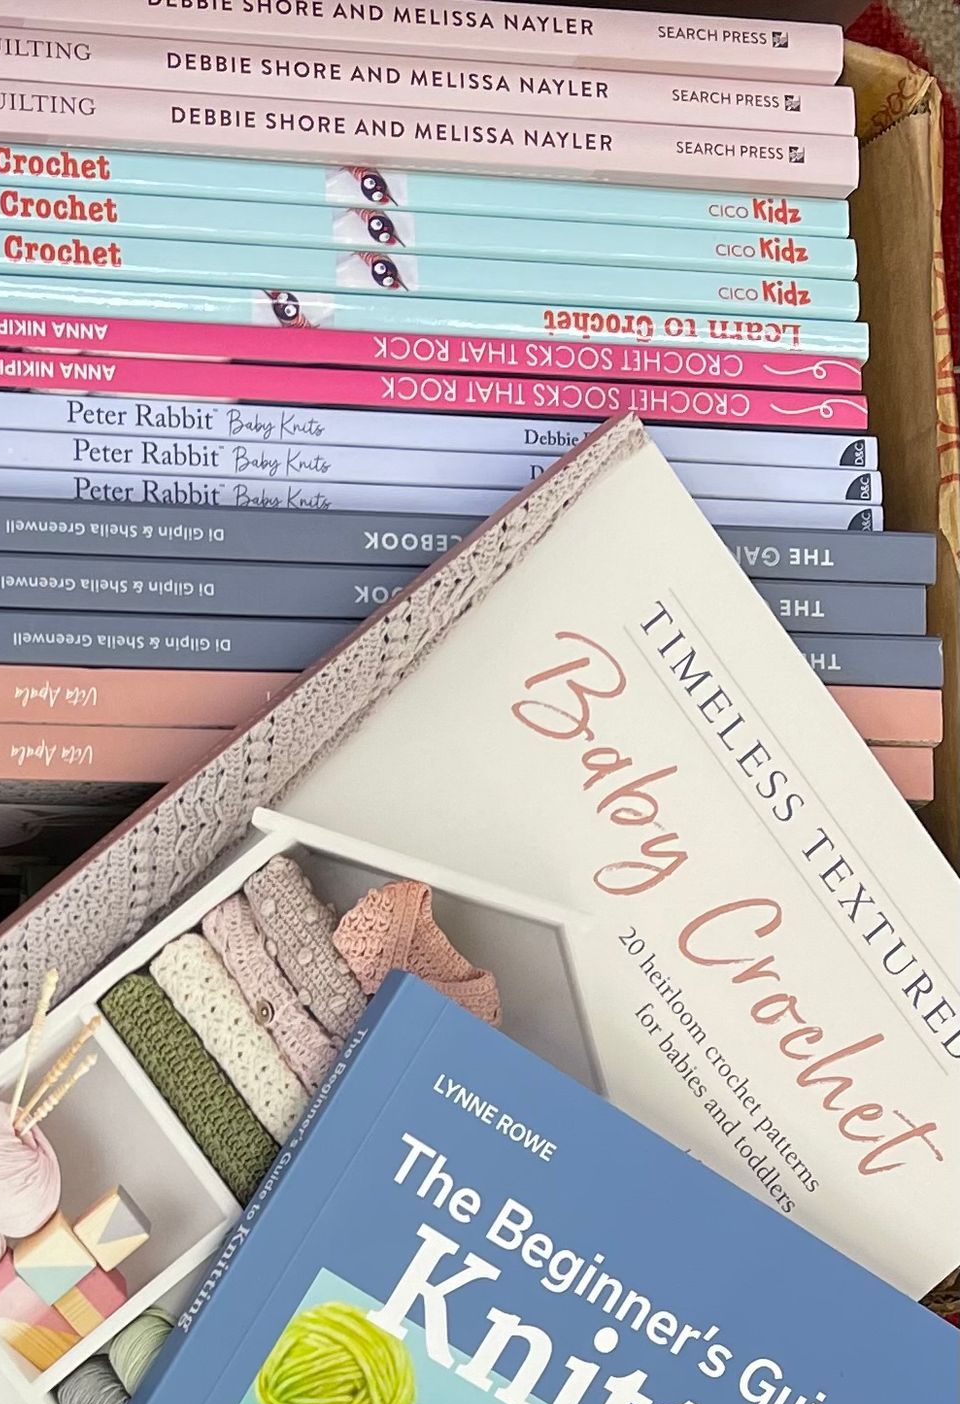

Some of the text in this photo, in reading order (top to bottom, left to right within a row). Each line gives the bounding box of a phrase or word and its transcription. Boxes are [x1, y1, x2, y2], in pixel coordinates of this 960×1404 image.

[166, 52, 609, 99] DEBBIE SHORE AND MELISSA NAYLER
[672, 89, 780, 108] SEARCH PRESS
[0, 190, 119, 224] Crochet
[715, 237, 809, 264] CICO Kidz
[51, 321, 108, 340] ANNA
[373, 335, 744, 377] CROCHET SOCKS THAT ROCK
[66, 400, 128, 426] Peter
[226, 409, 275, 440] Baby
[280, 411, 325, 440] Knits
[523, 428, 580, 447] Debbie
[6, 519, 85, 535] Greenwell
[142, 526, 153, 539] &
[158, 527, 204, 541] Gilpin
[208, 528, 224, 542] Di
[788, 548, 835, 567] THE
[638, 600, 806, 824] TIMELESS
[511, 630, 945, 1176] Baby Crochet
[618, 926, 820, 1193] 20 heirloom crochet patterns
[432, 1072, 560, 1163] LYNNE ROWE
[635, 1002, 796, 1214] for babies and toddlers
[392, 1132, 483, 1225] The
[483, 1198, 736, 1380] Beginner's
[178, 1224, 249, 1333] Knitting
